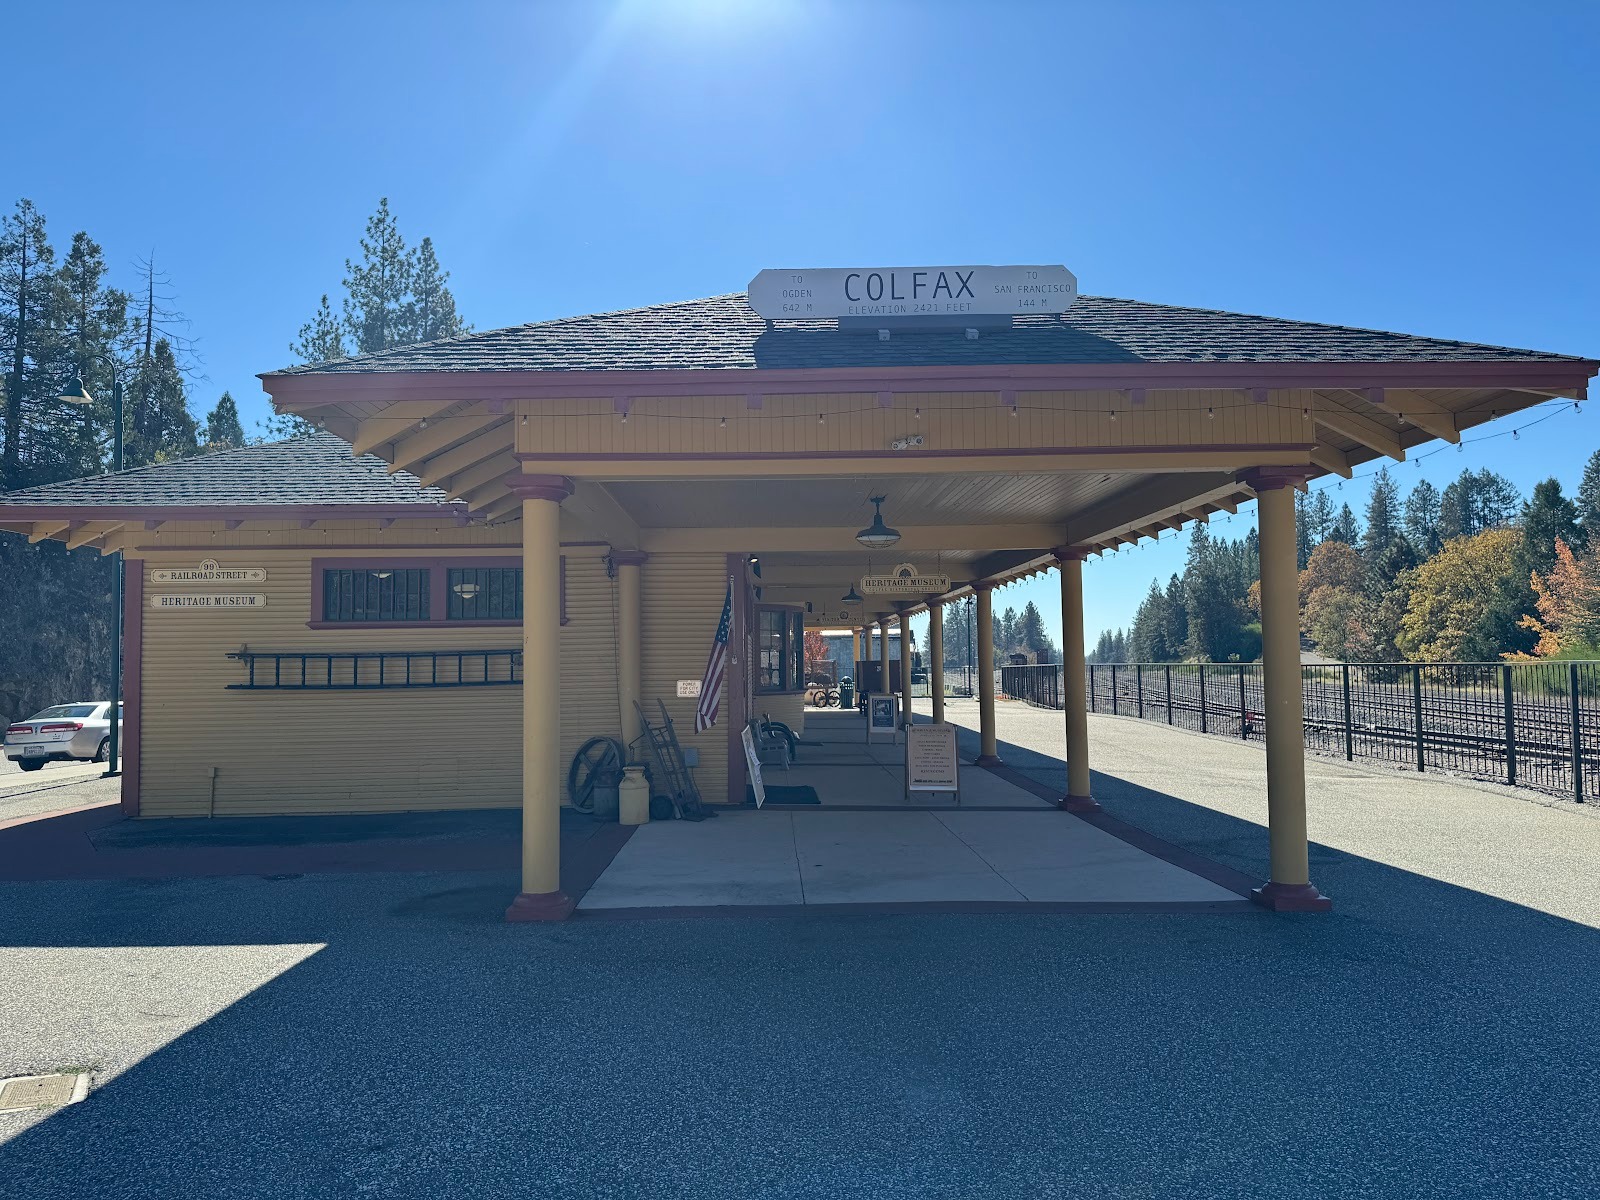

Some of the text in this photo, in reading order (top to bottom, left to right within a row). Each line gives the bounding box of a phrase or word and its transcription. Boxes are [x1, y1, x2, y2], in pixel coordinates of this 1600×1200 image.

[791, 275, 803, 284] TO
[1026, 271, 1038, 280] TO
[844, 271, 975, 302] COLFAX
[994, 284, 1071, 294] SAN FRANCISCO
[782, 289, 812, 298] OGDEN
[782, 303, 813, 312] 642 M
[1018, 298, 1048, 308] 144 M
[848, 302, 972, 315] ELEVATION 2421 FEET
[203, 563, 215, 571] 99
[170, 571, 248, 580] RAILROAD STREET
[865, 578, 947, 587] HERITAGE MUSEUM
[161, 596, 256, 606] HERITAGE MUSEUM
